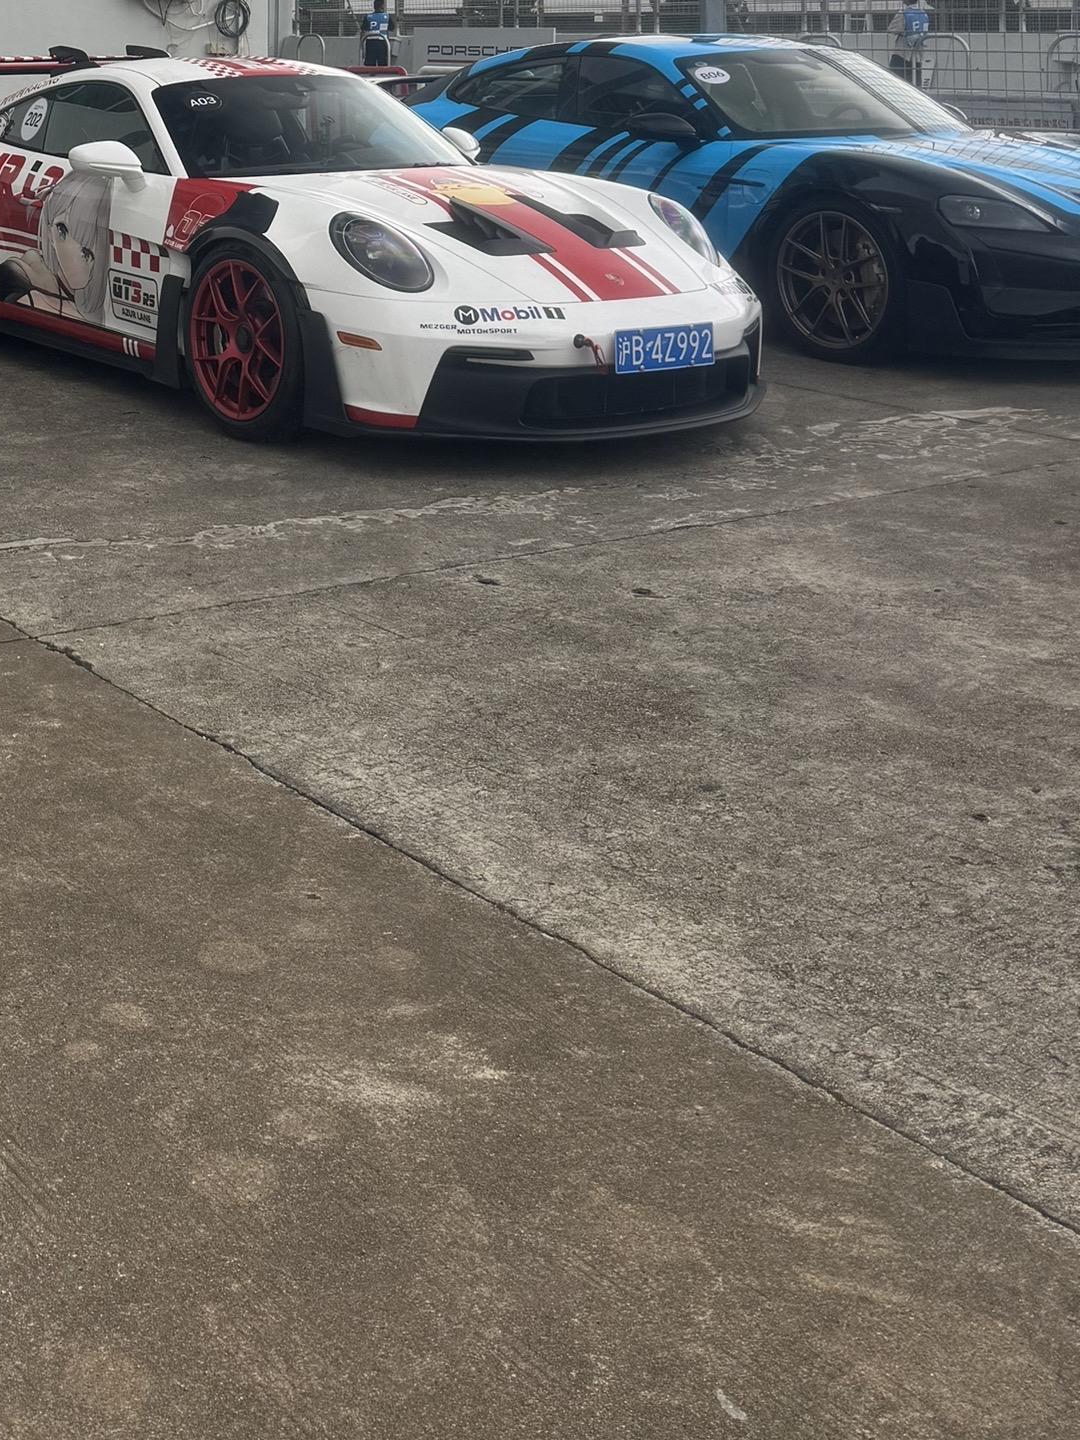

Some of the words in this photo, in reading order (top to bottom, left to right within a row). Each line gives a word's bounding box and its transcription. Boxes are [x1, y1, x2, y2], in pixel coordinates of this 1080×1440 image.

[700, 71, 725, 80] B06
[190, 97, 217, 107] A03
[24, 112, 43, 127] 202
[112, 276, 142, 304] GT3
[142, 292, 156, 308] RS
[122, 307, 137, 319] AZUR
[137, 312, 151, 323] LANE
[479, 306, 542, 322] Mobil
